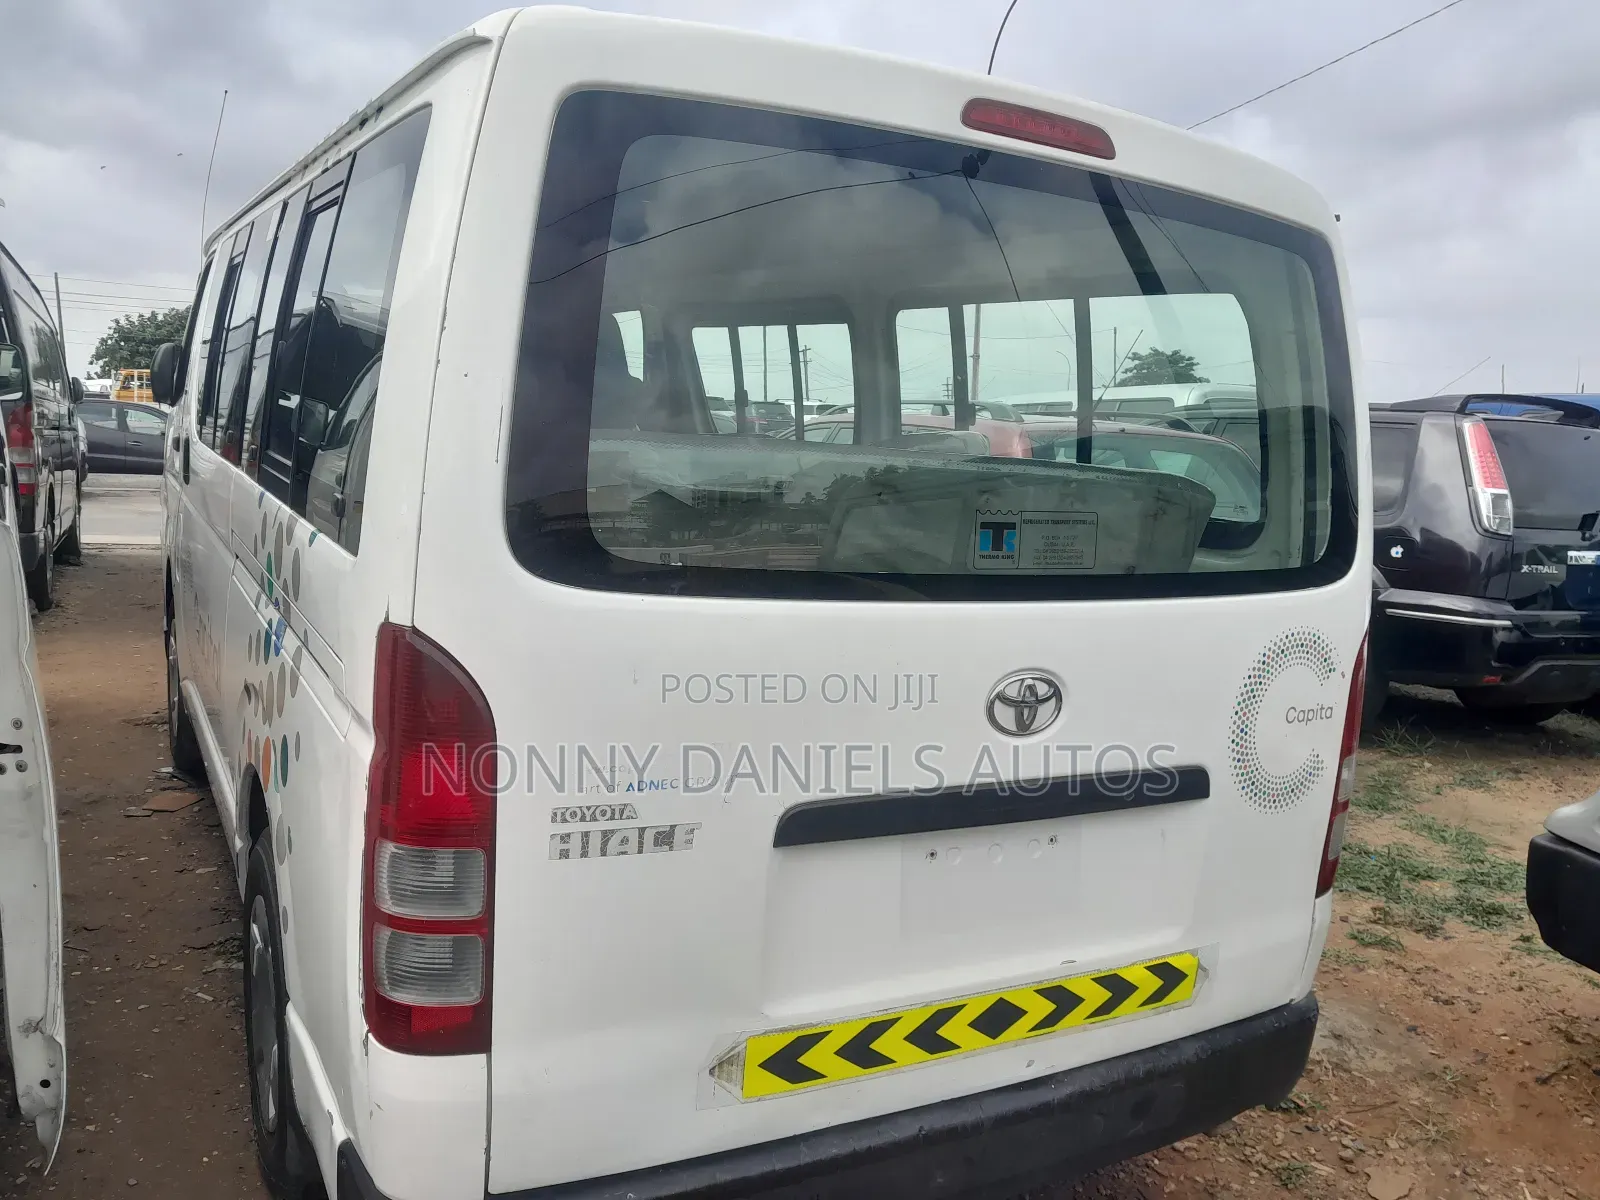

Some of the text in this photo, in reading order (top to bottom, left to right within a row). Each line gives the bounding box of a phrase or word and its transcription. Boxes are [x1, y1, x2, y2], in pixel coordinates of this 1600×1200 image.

[1521, 564, 1558, 573] X-TRAIL
[625, 778, 679, 792] ADNEC
[550, 803, 640, 824] TOYOTA
[548, 822, 703, 861] HIACE
